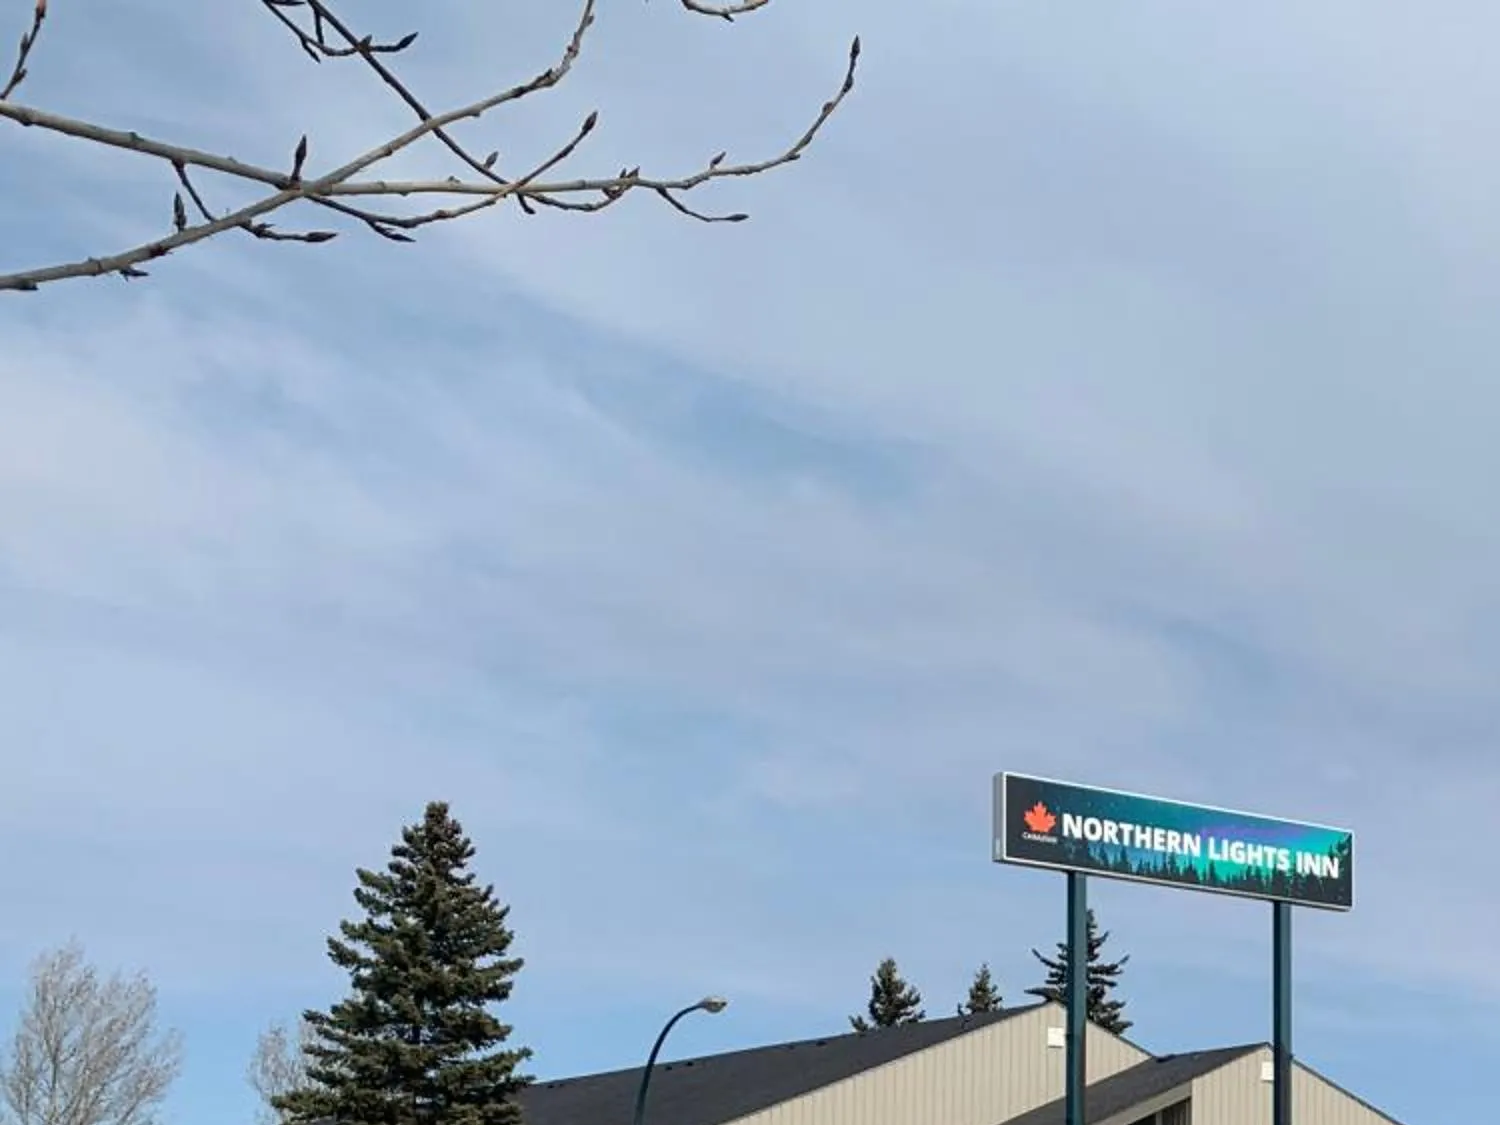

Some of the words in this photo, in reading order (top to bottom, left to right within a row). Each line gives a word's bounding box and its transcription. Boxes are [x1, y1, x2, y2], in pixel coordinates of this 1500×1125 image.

[1062, 813, 1201, 857] NORTHERN
[1208, 837, 1290, 872] LIGHTS
[1296, 851, 1339, 879] INN
